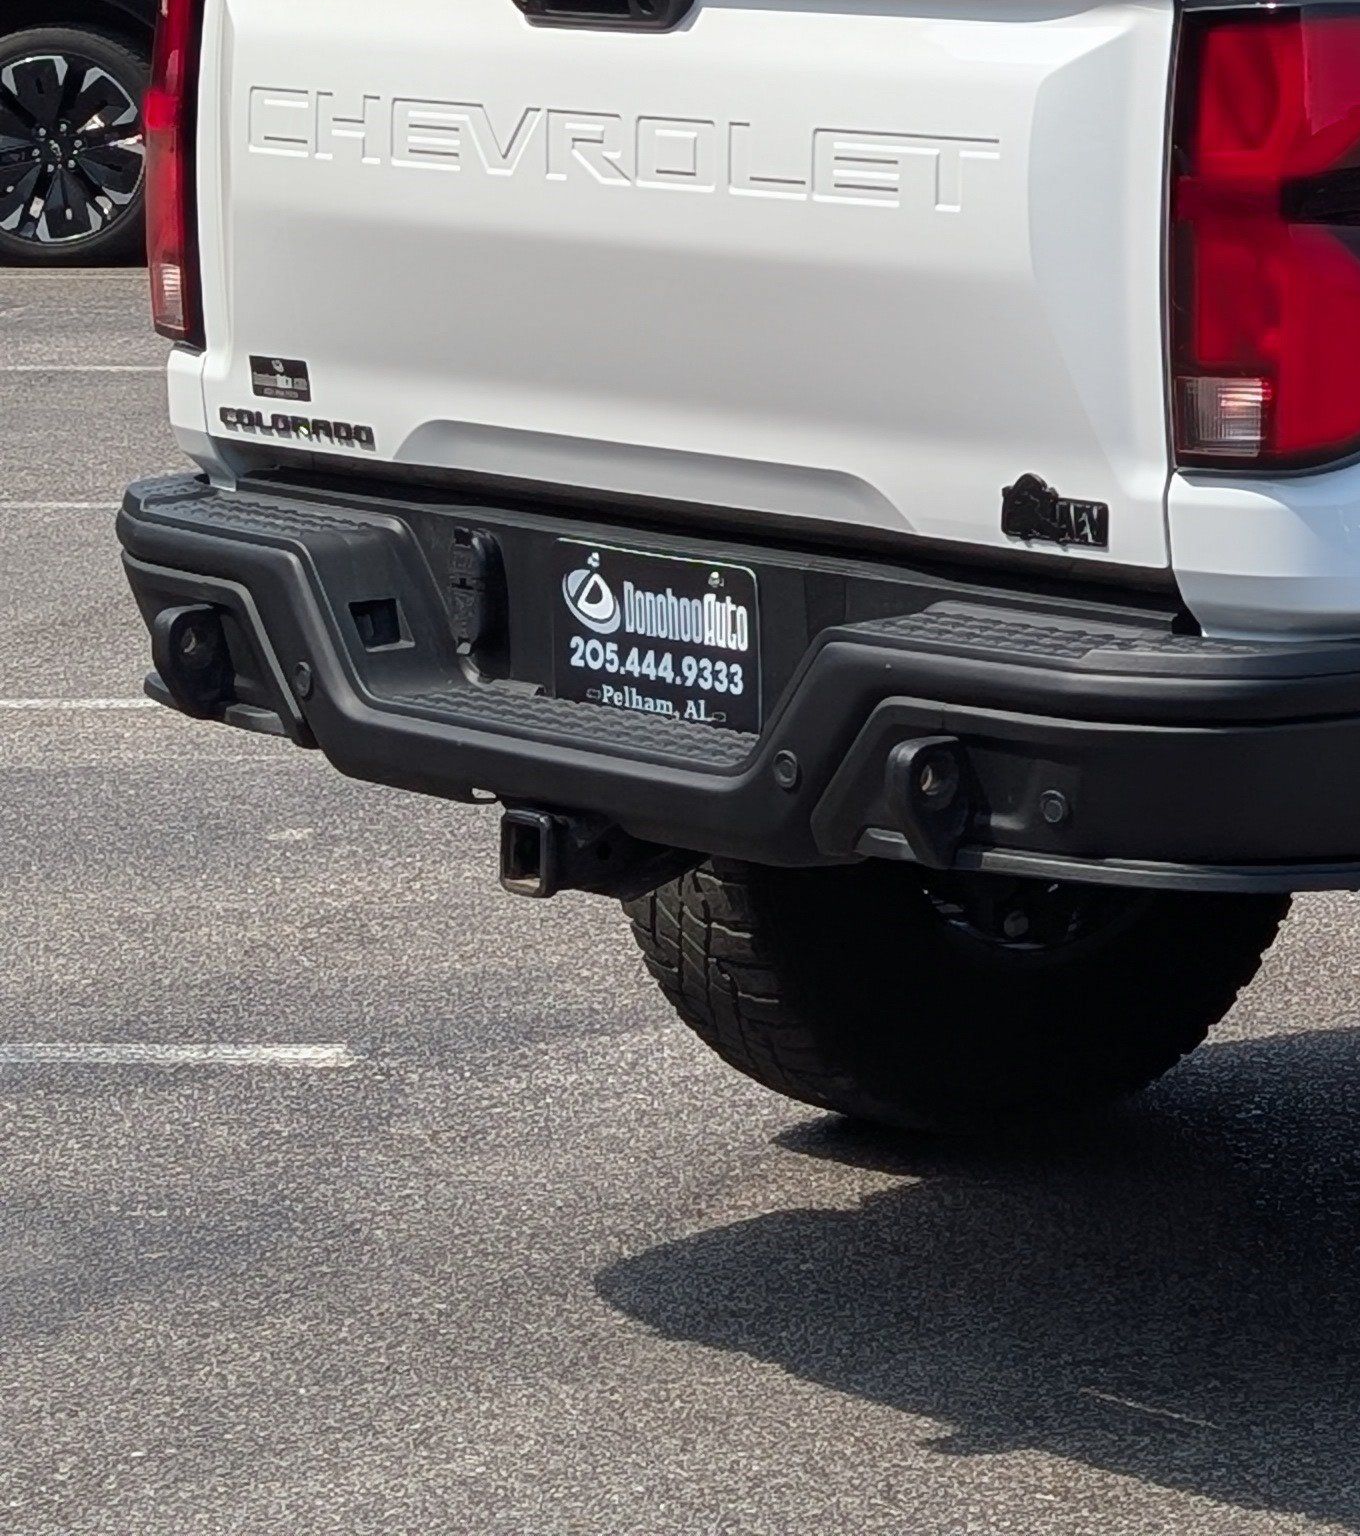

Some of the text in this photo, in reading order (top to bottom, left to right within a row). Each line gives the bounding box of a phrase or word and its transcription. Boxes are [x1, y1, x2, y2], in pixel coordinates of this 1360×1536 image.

[247, 85, 1001, 212] CHEVROLET
[219, 406, 376, 444] COLORADO
[569, 634, 744, 696] 205.444.9333
[601, 683, 715, 722] Pelham, AL
